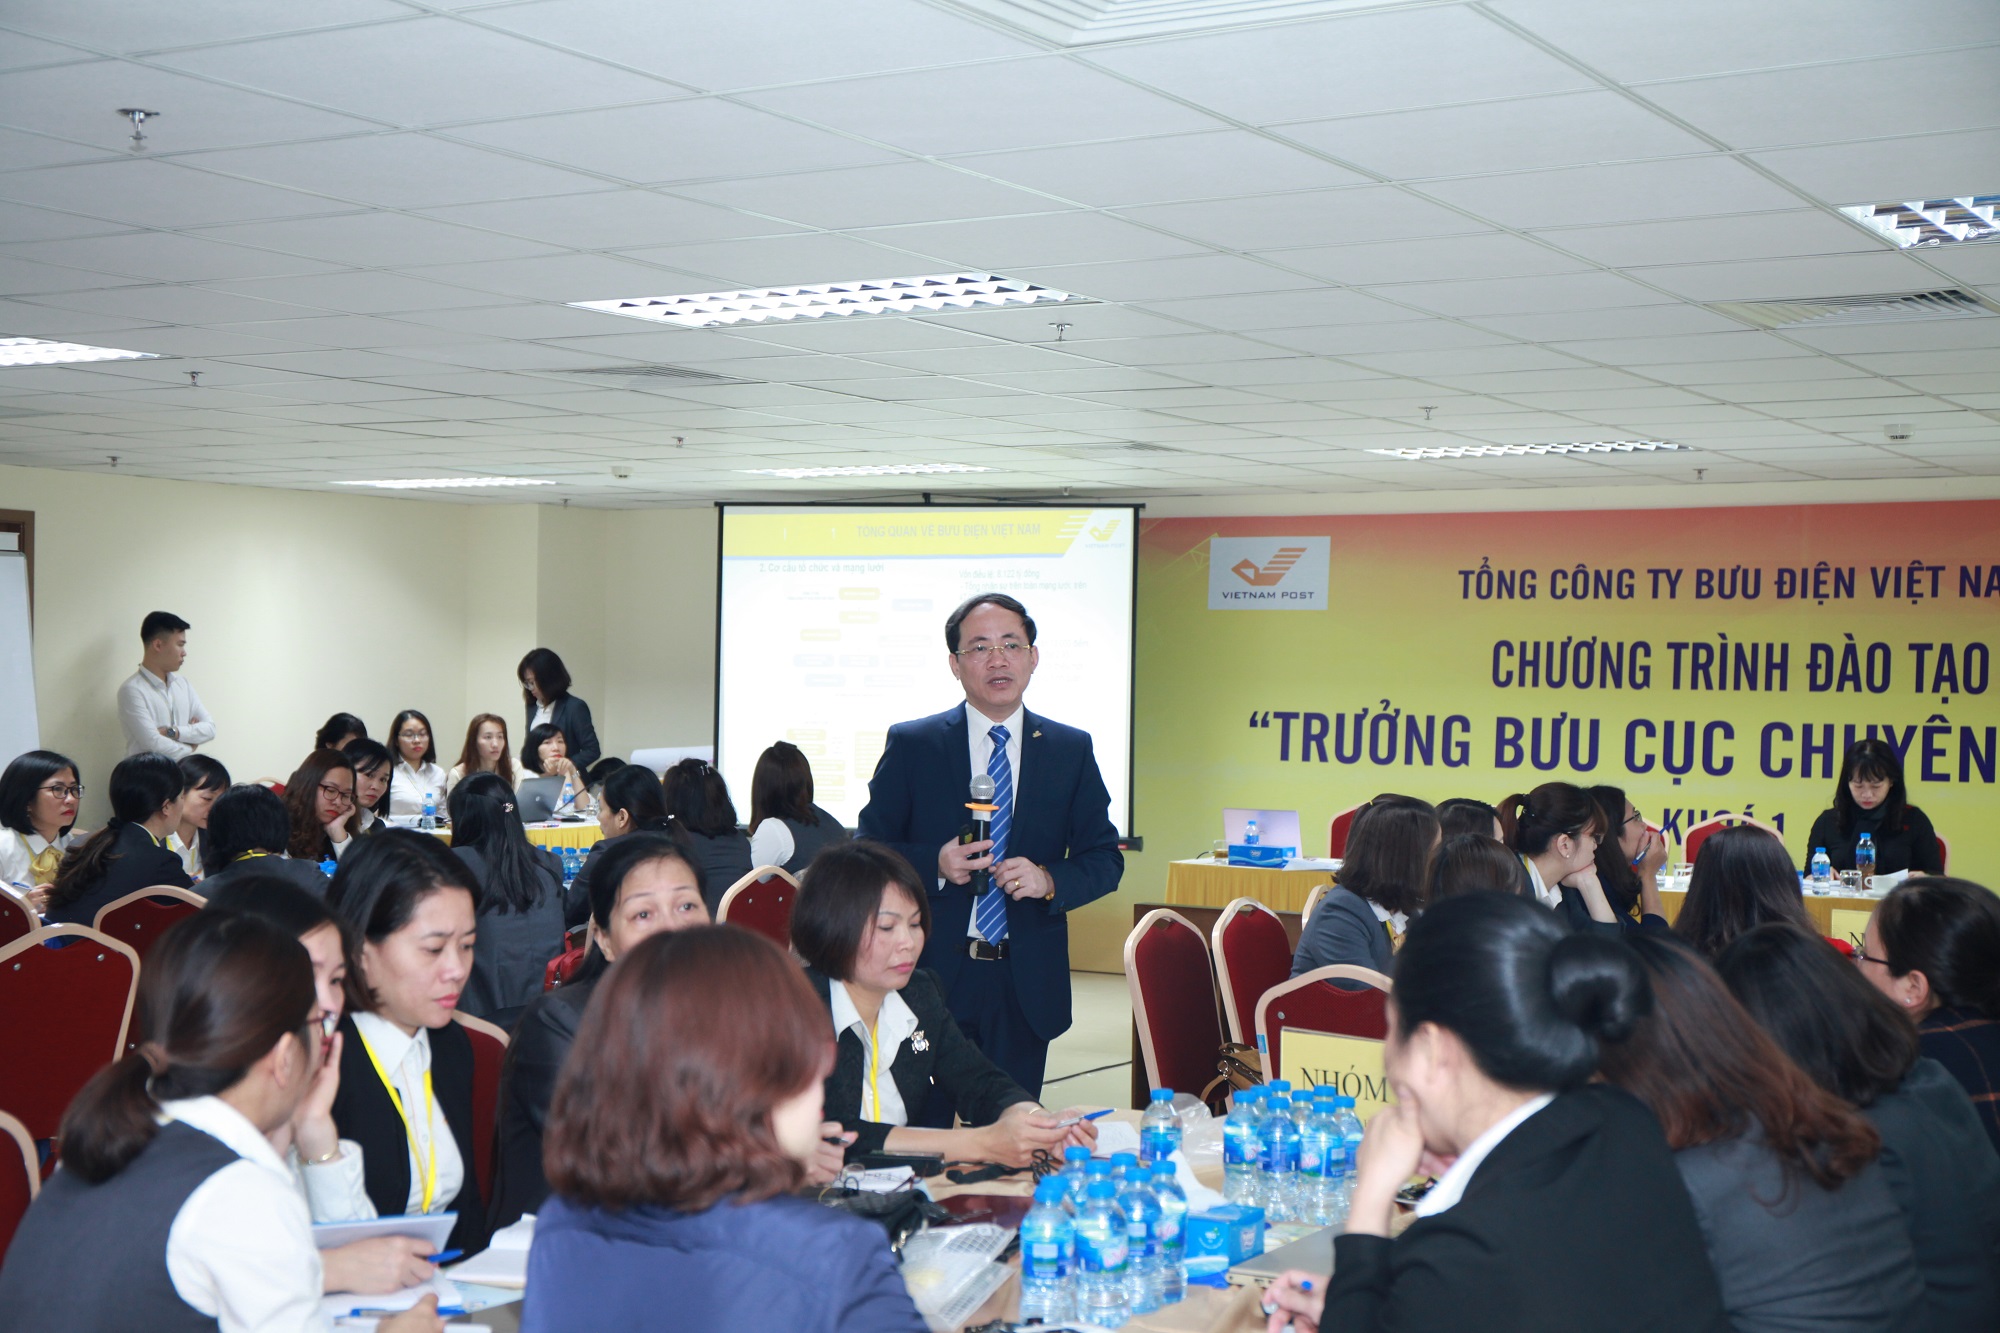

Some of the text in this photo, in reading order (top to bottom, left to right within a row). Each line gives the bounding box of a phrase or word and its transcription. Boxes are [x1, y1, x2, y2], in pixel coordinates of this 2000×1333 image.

[888, 525, 917, 537] QUAN
[1017, 523, 1040, 536] NAM
[1222, 591, 1315, 599] VIETNAM POST
[1458, 556, 1537, 600] TỔNG
[1550, 563, 1635, 600] CÔNG
[1647, 568, 1684, 599] TY
[1695, 564, 1762, 600] BƯU
[1774, 561, 1856, 606] ĐIỆN
[1870, 560, 1946, 605] VIỆT
[1492, 632, 1990, 704] CHƯƠNG TRÌNH ĐÀO TẠO
[1494, 711, 1600, 772] BƯU
[1624, 718, 1735, 785] CỤC
[1300, 1064, 1389, 1103] NHÓM
